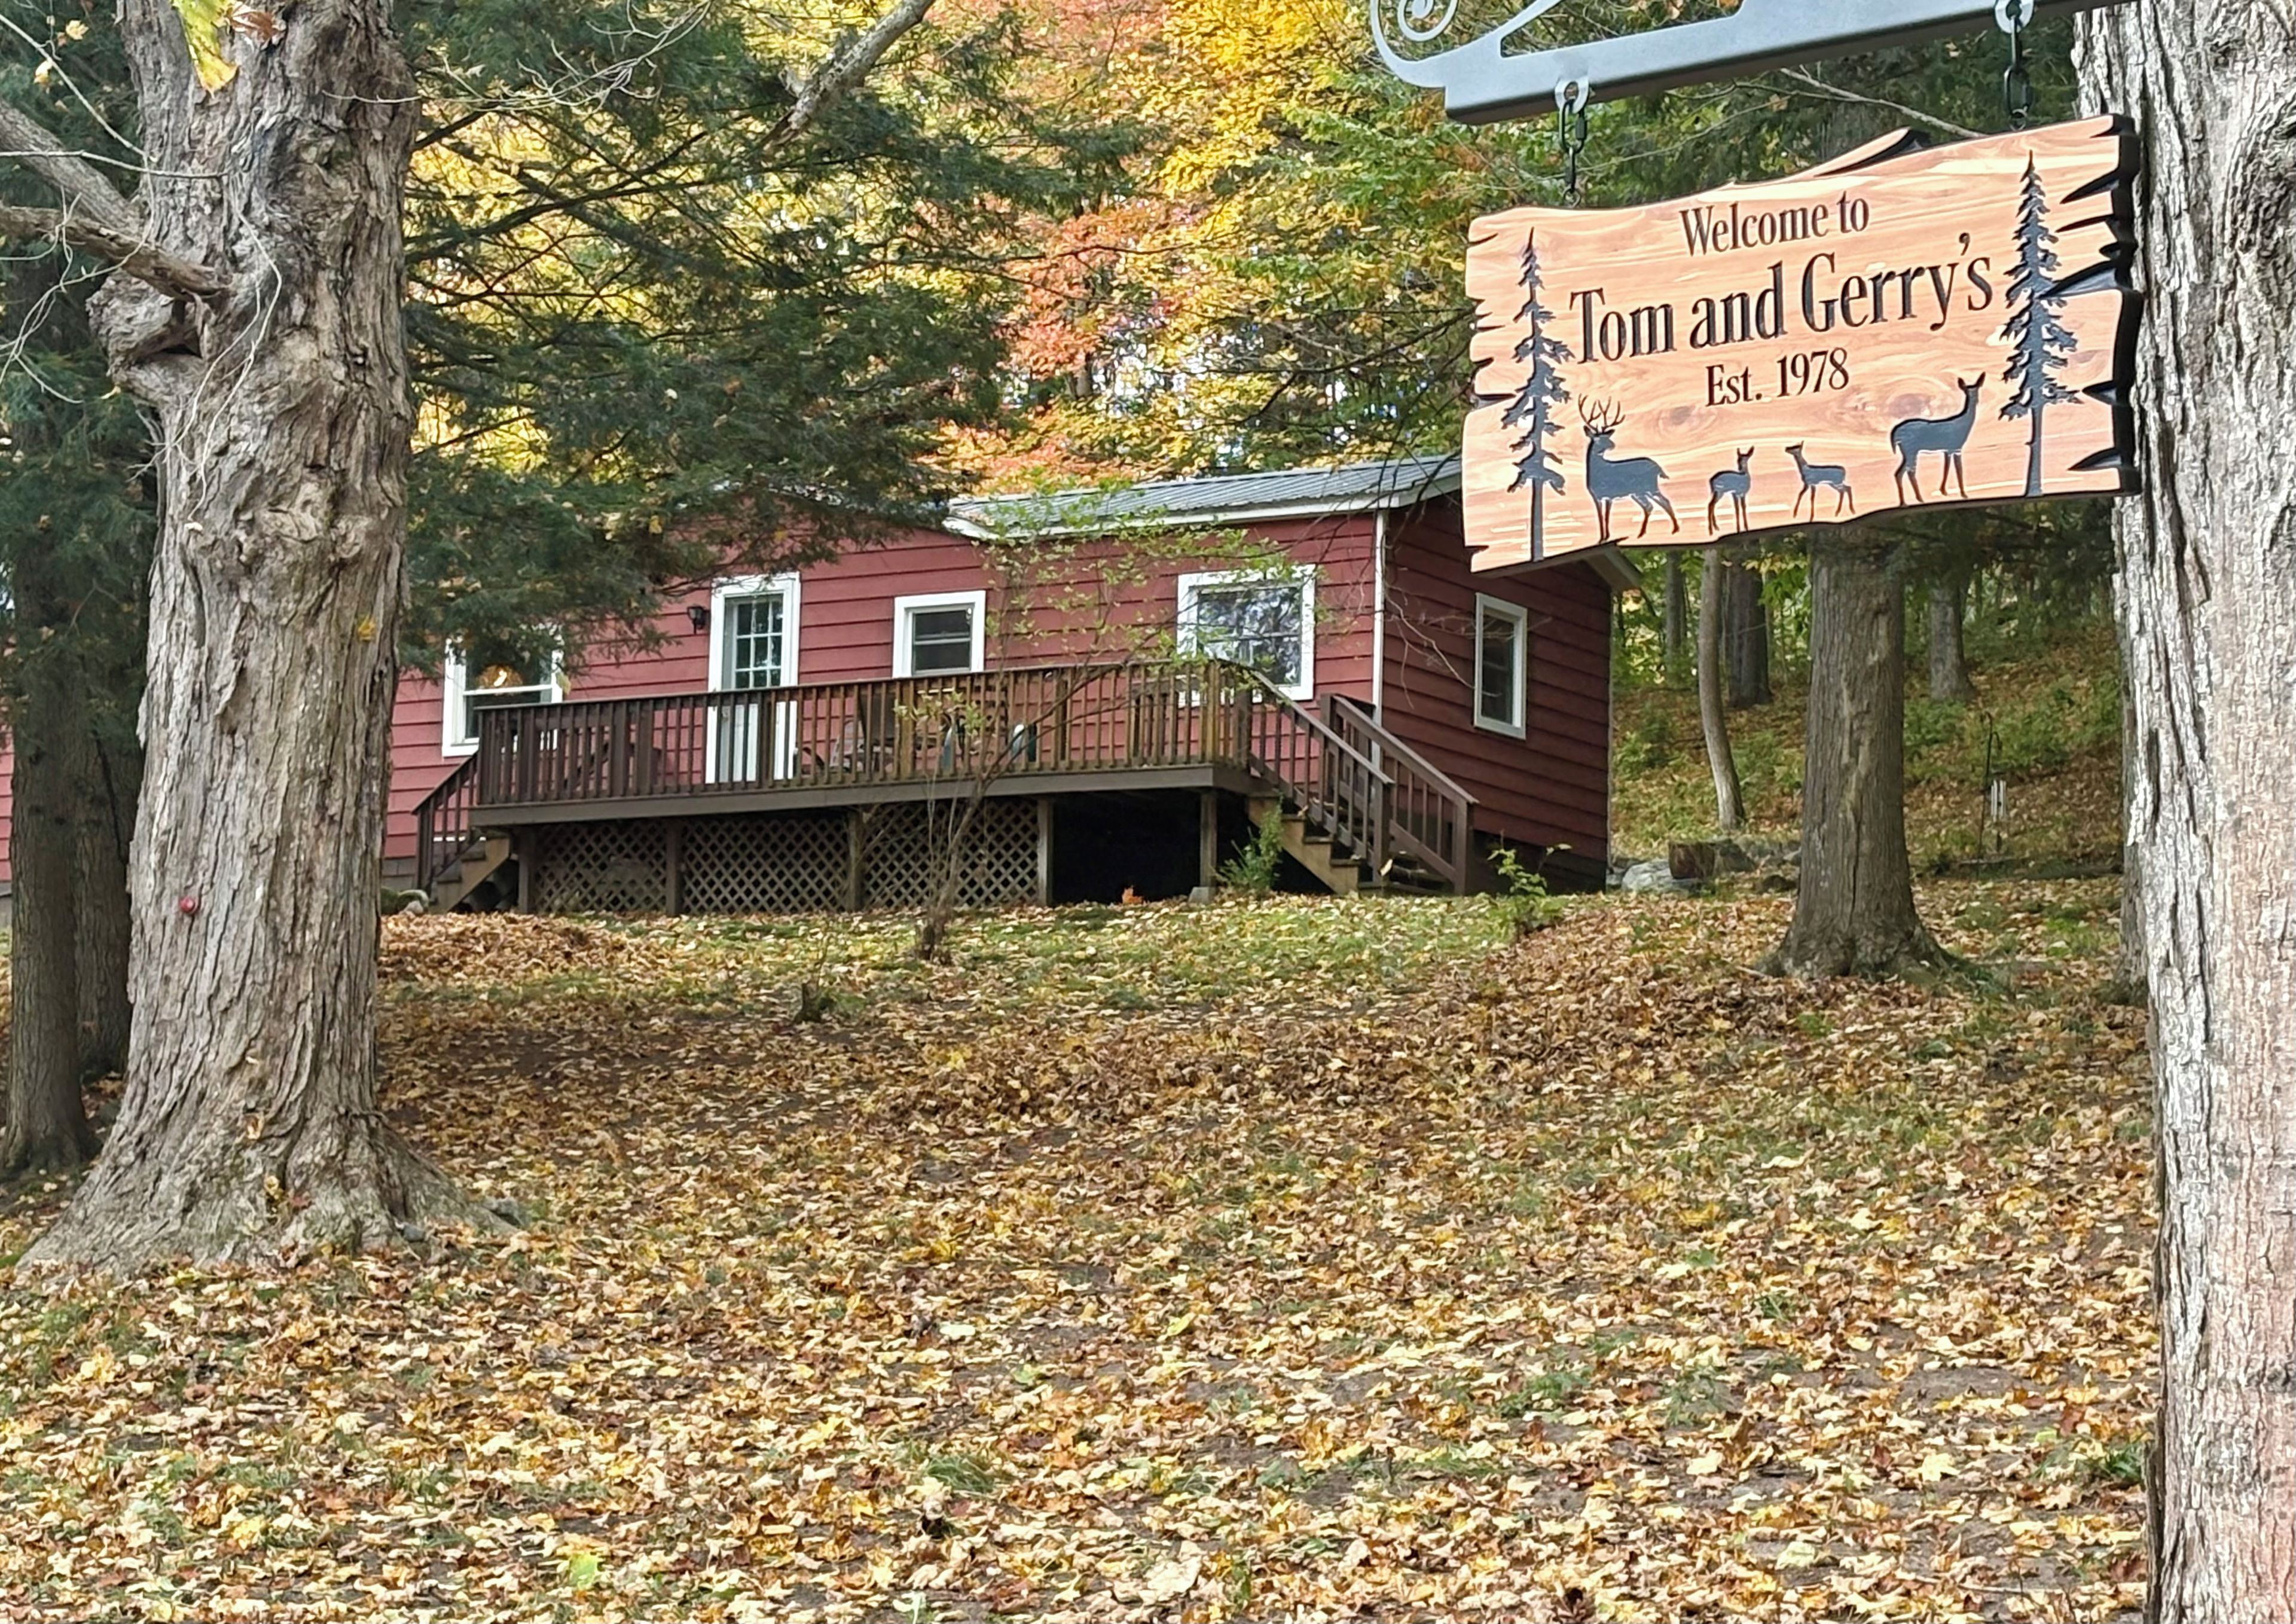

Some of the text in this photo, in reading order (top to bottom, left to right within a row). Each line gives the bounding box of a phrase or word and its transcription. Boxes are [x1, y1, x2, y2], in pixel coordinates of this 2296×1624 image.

[1680, 191, 1869, 257] Welcome to
[1570, 232, 1993, 364] Tom and Gerry's
[1705, 348, 1851, 407] Est. 1978
